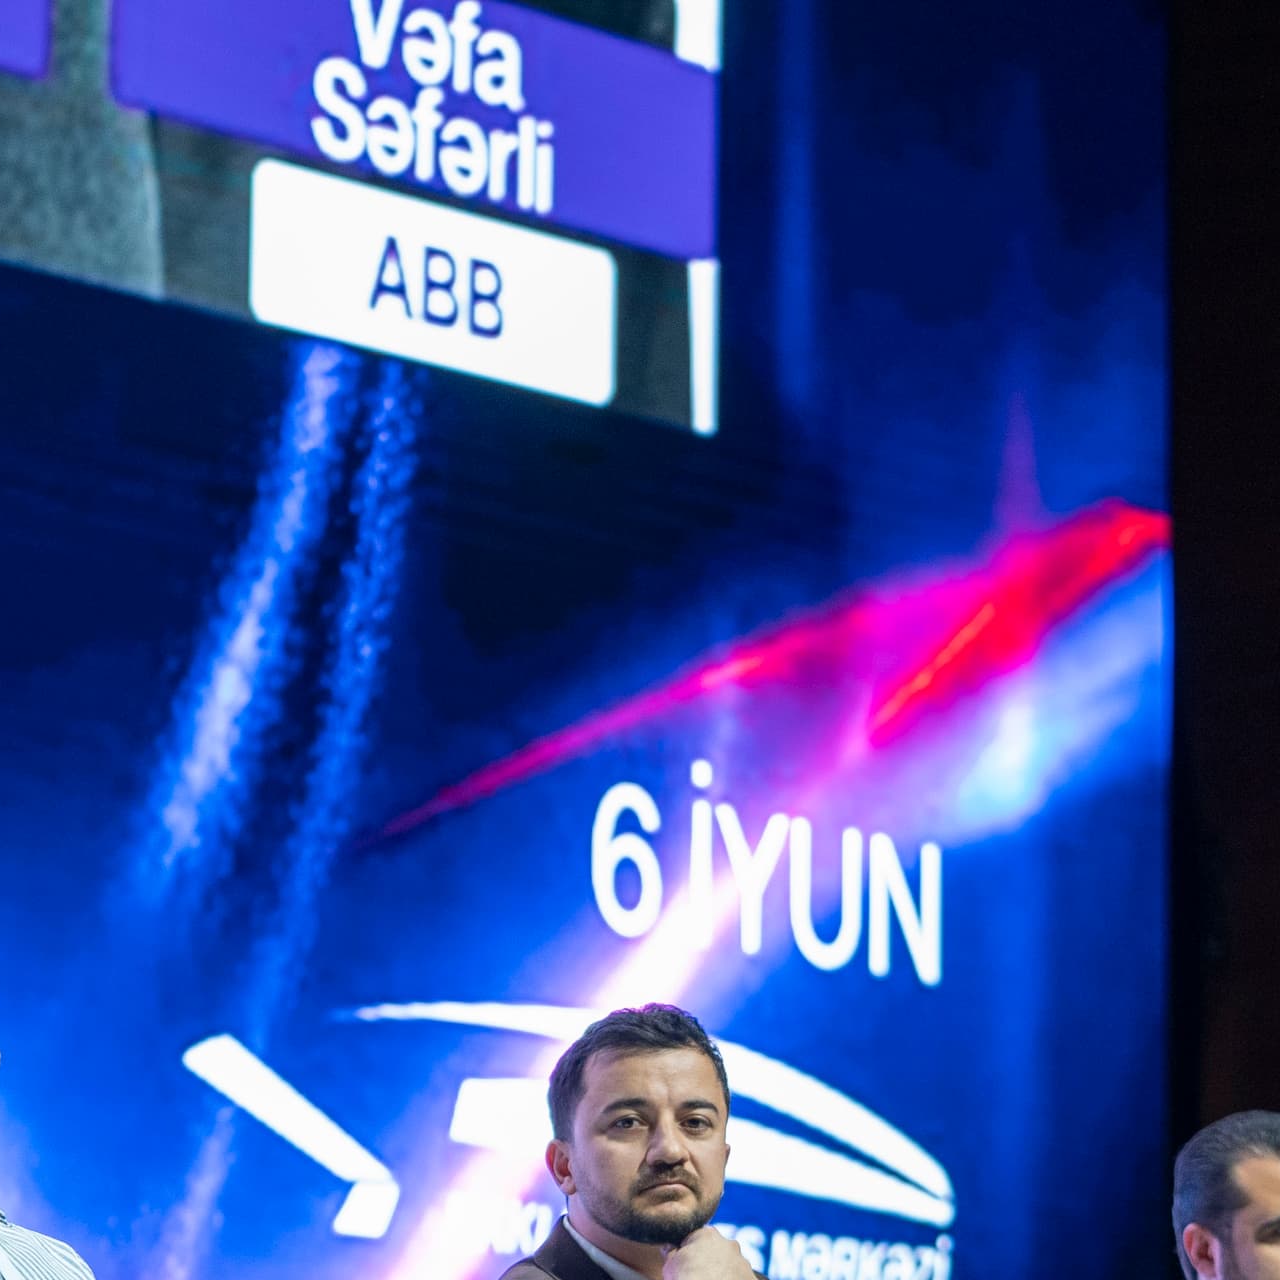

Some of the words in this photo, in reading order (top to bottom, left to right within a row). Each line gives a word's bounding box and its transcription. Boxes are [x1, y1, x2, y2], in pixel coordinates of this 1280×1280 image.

[350, 0, 525, 112] Vəfa
[311, 57, 553, 214] Səfərli
[370, 236, 502, 338] ABB
[591, 782, 662, 937] 6
[690, 759, 941, 986] İYUN
